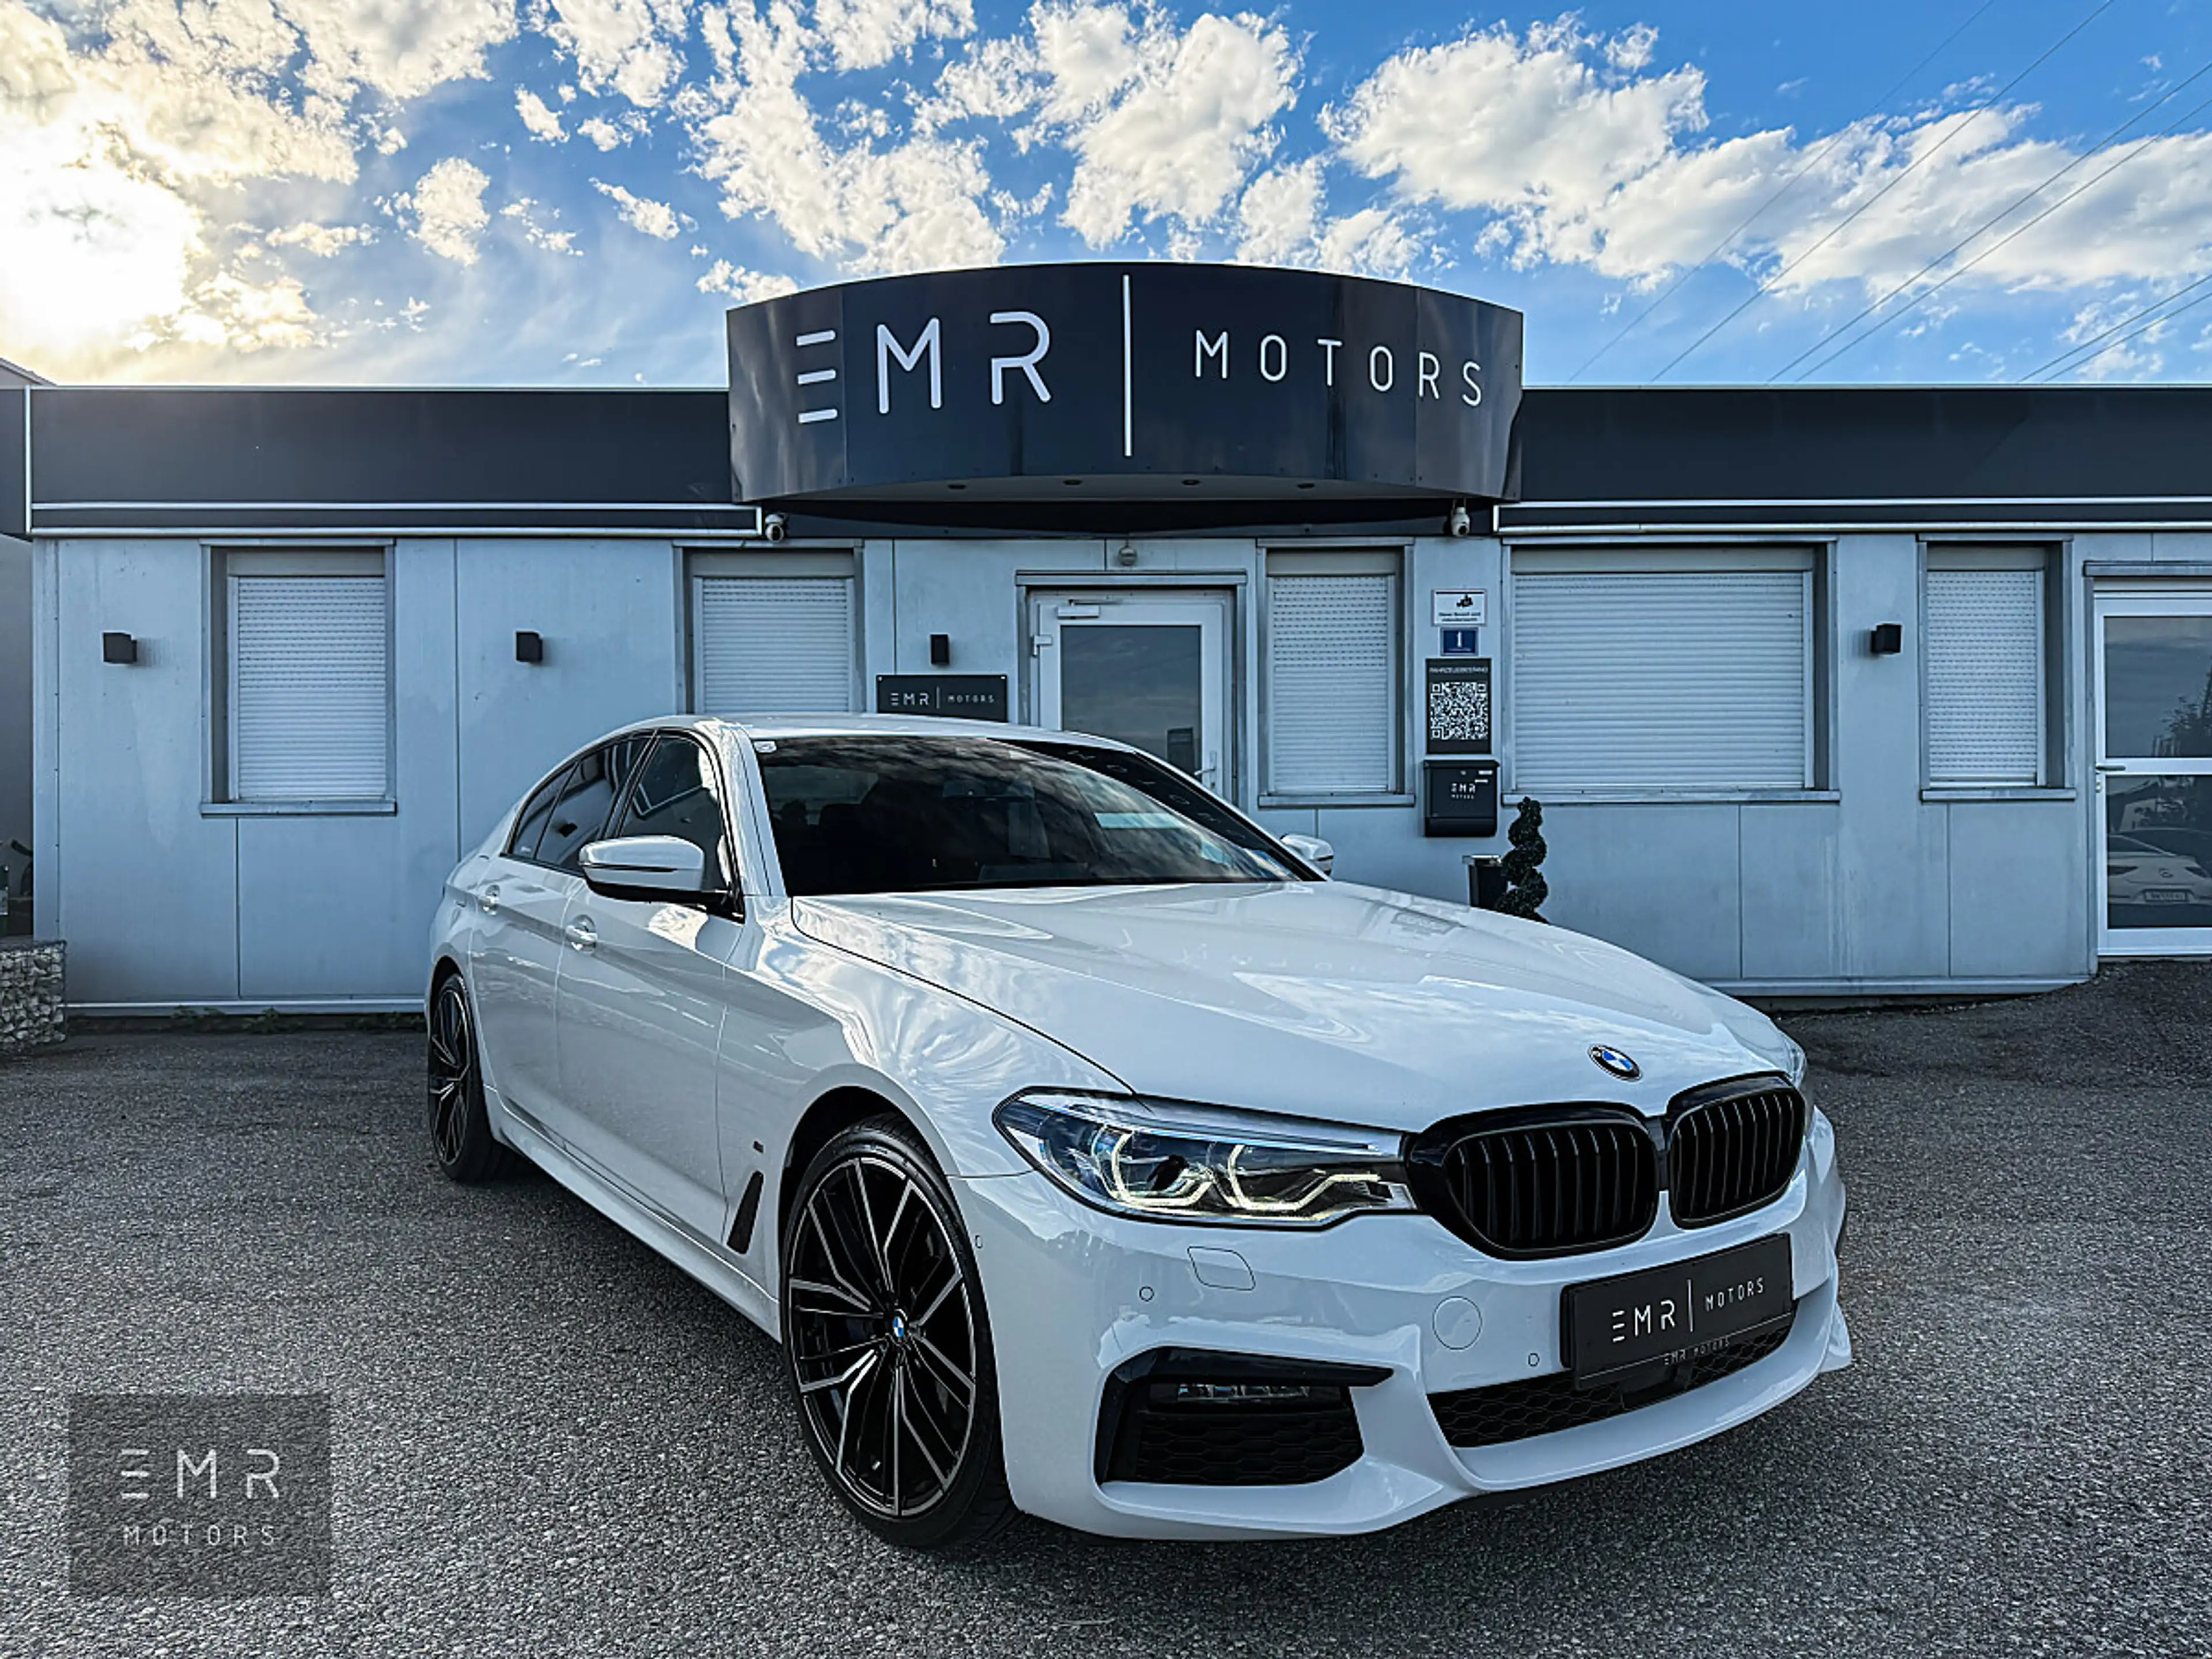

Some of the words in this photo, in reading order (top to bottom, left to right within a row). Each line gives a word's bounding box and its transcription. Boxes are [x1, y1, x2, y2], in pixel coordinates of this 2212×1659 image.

[796, 310, 1051, 423] EMR
[1195, 329, 1482, 407] MOTORS
[891, 692, 930, 706] EMR
[948, 694, 995, 704] MOTORS
[1612, 1300, 1676, 1343] EMR
[1705, 1277, 1764, 1312] MOTORS
